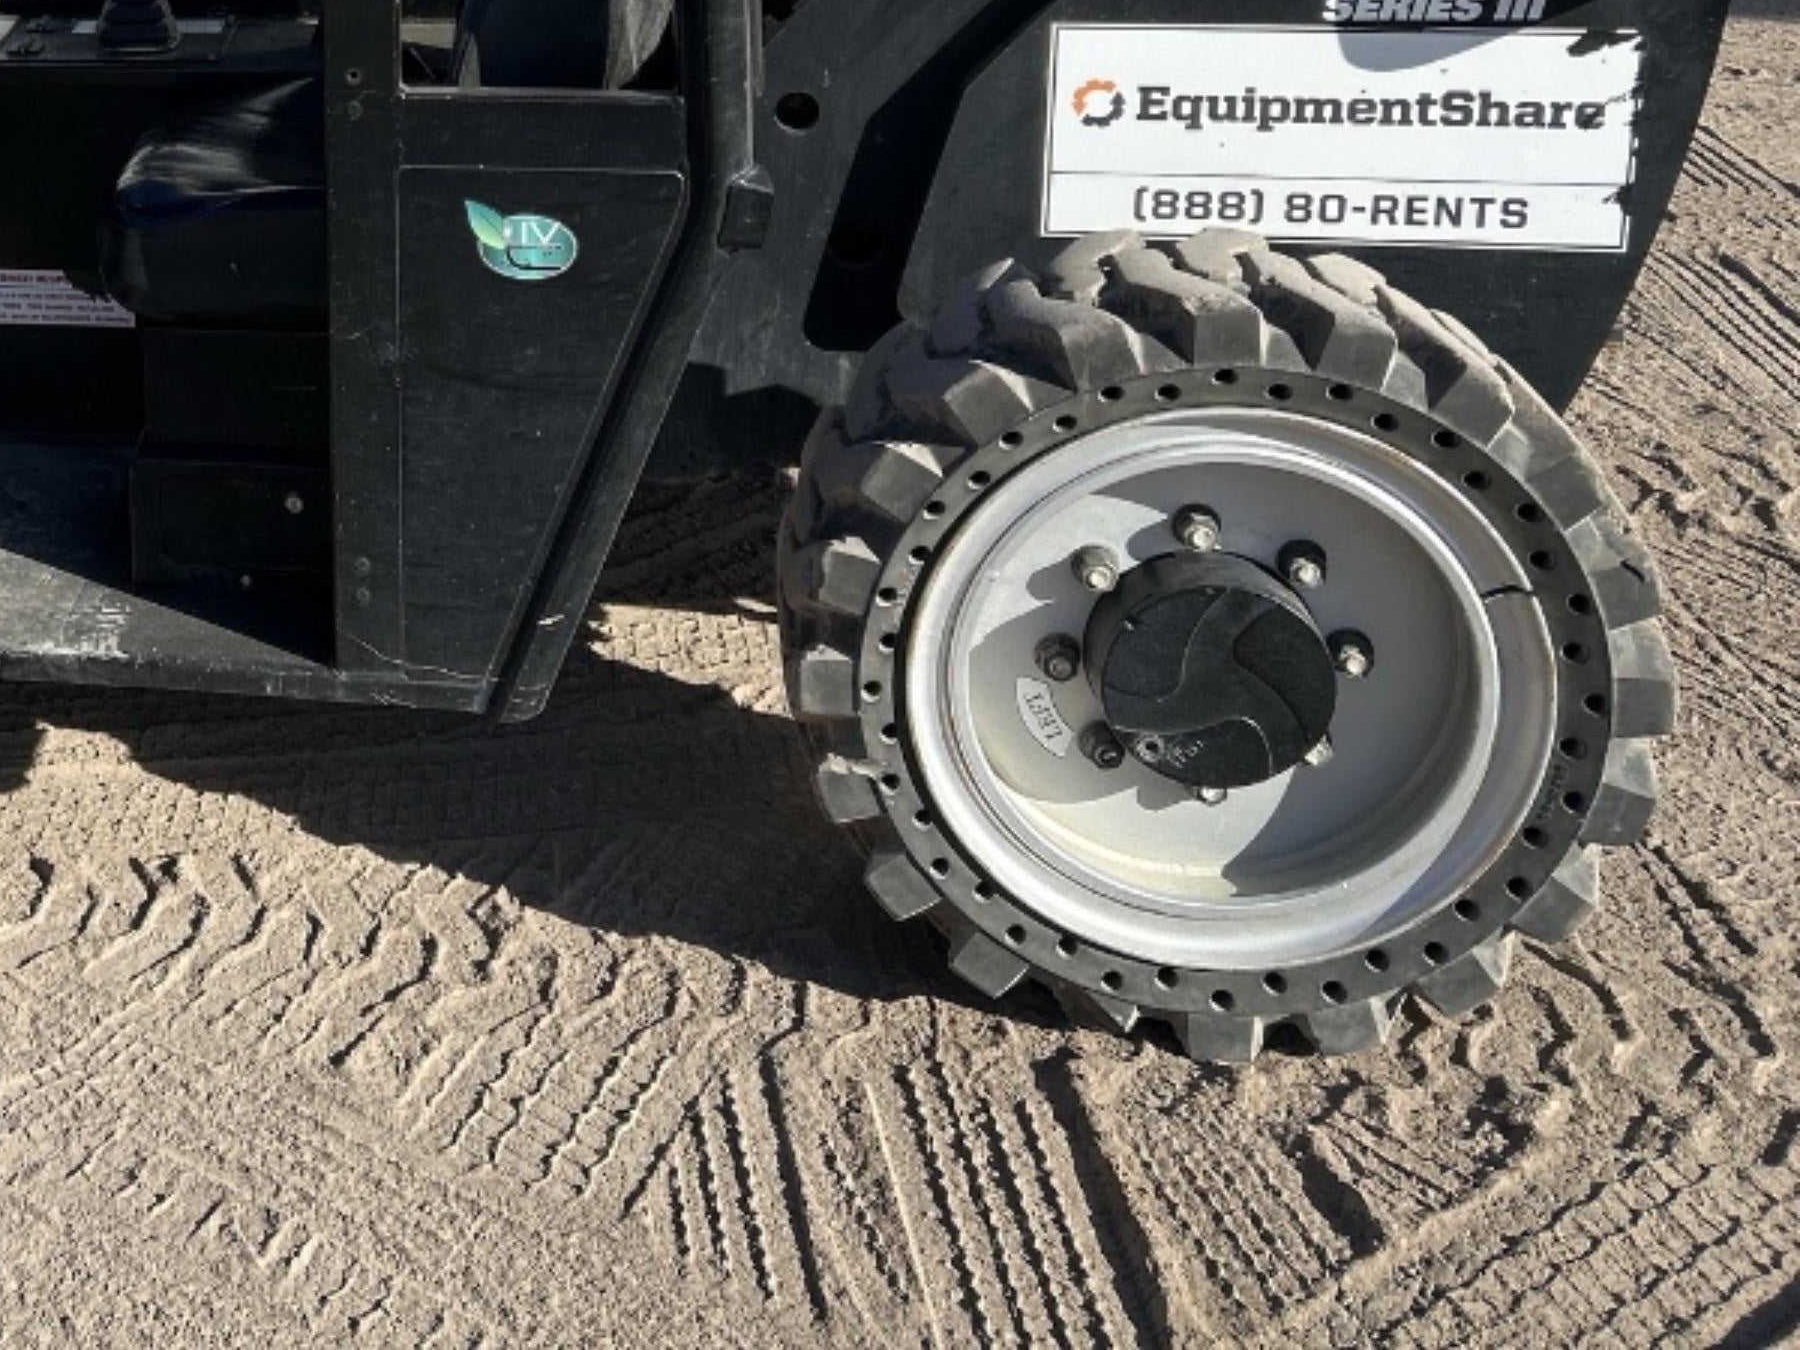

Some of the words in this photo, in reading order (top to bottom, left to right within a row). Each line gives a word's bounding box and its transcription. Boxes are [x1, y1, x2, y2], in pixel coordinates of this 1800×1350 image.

[1135, 85, 1607, 131] EquipmentShare
[1132, 185, 1265, 225] (888)
[1283, 192, 1530, 230] 80-RENTS
